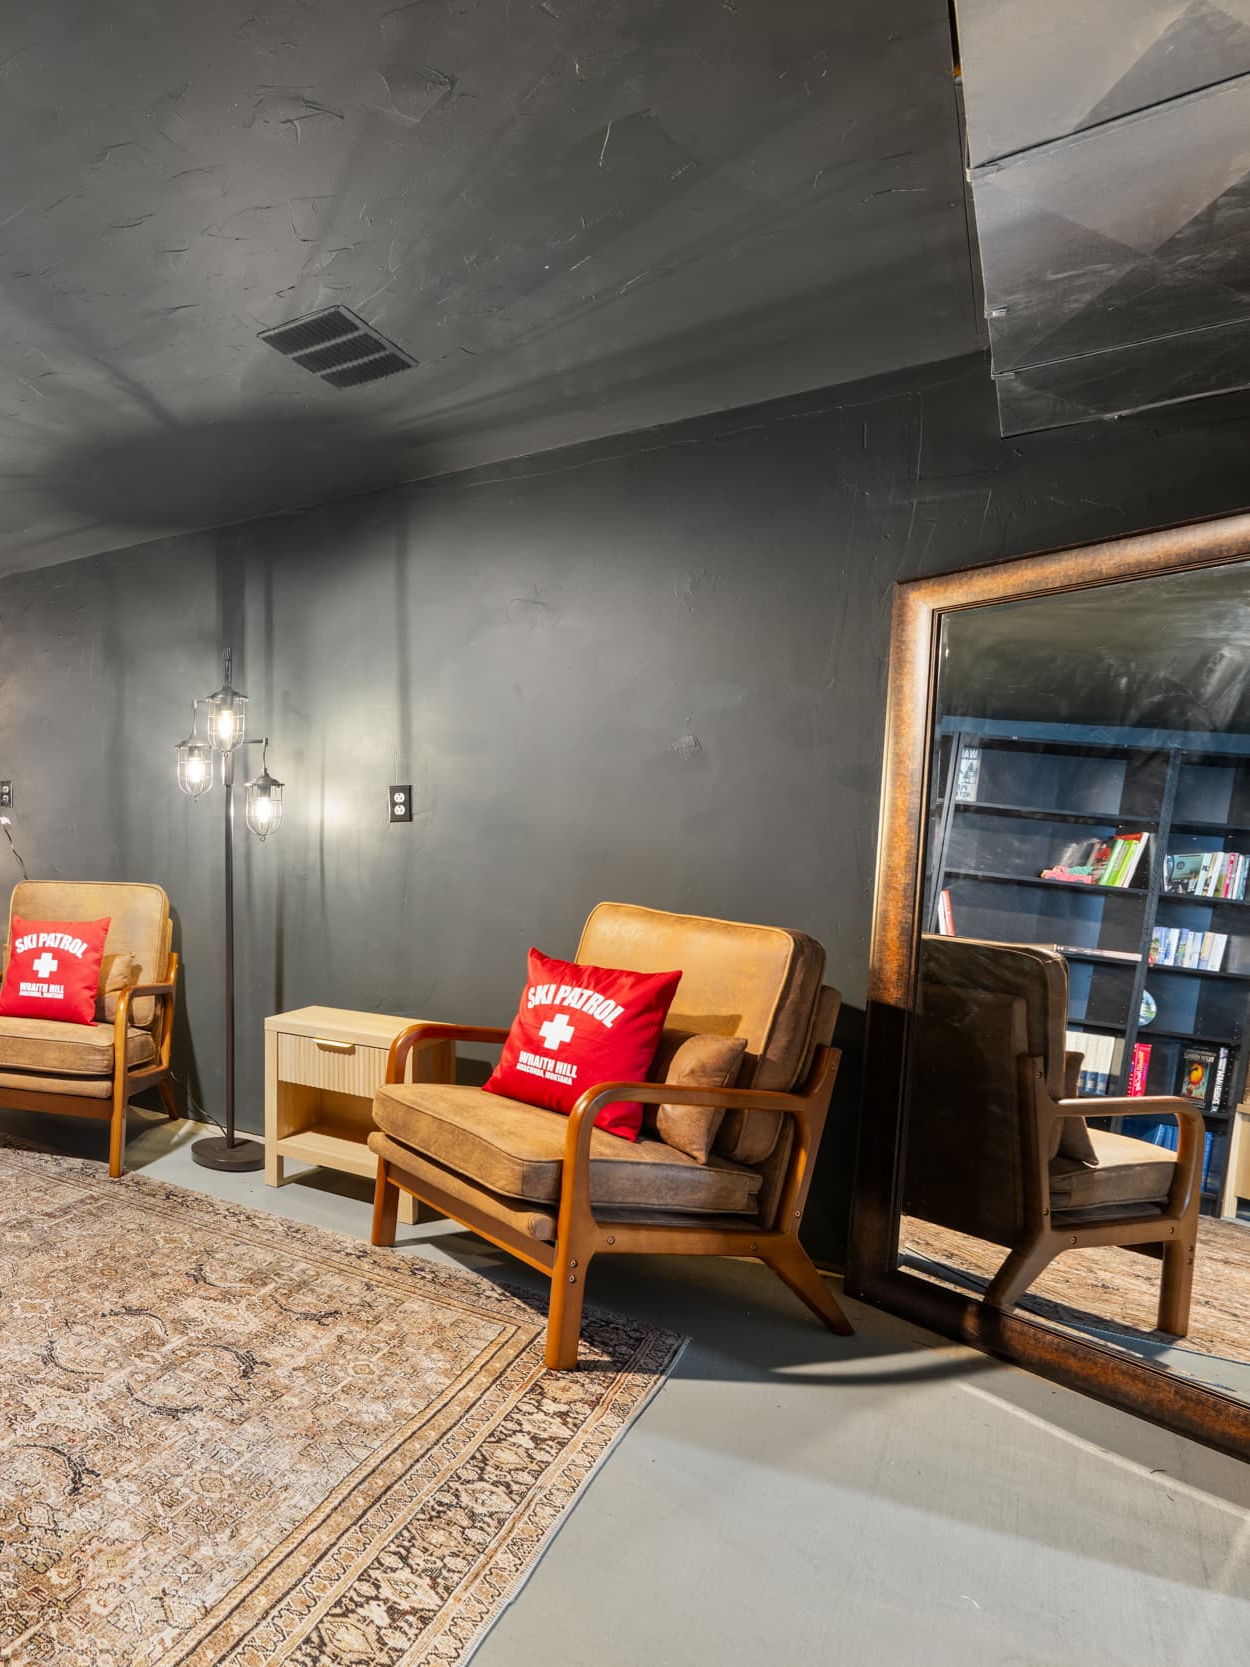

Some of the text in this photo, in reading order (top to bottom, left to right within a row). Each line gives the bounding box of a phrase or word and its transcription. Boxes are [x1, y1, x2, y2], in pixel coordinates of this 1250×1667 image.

[14, 932, 88, 959] SKI PATROL
[528, 984, 625, 1029] SKI PATROL
[518, 1050, 578, 1078] WRAITH HILL
